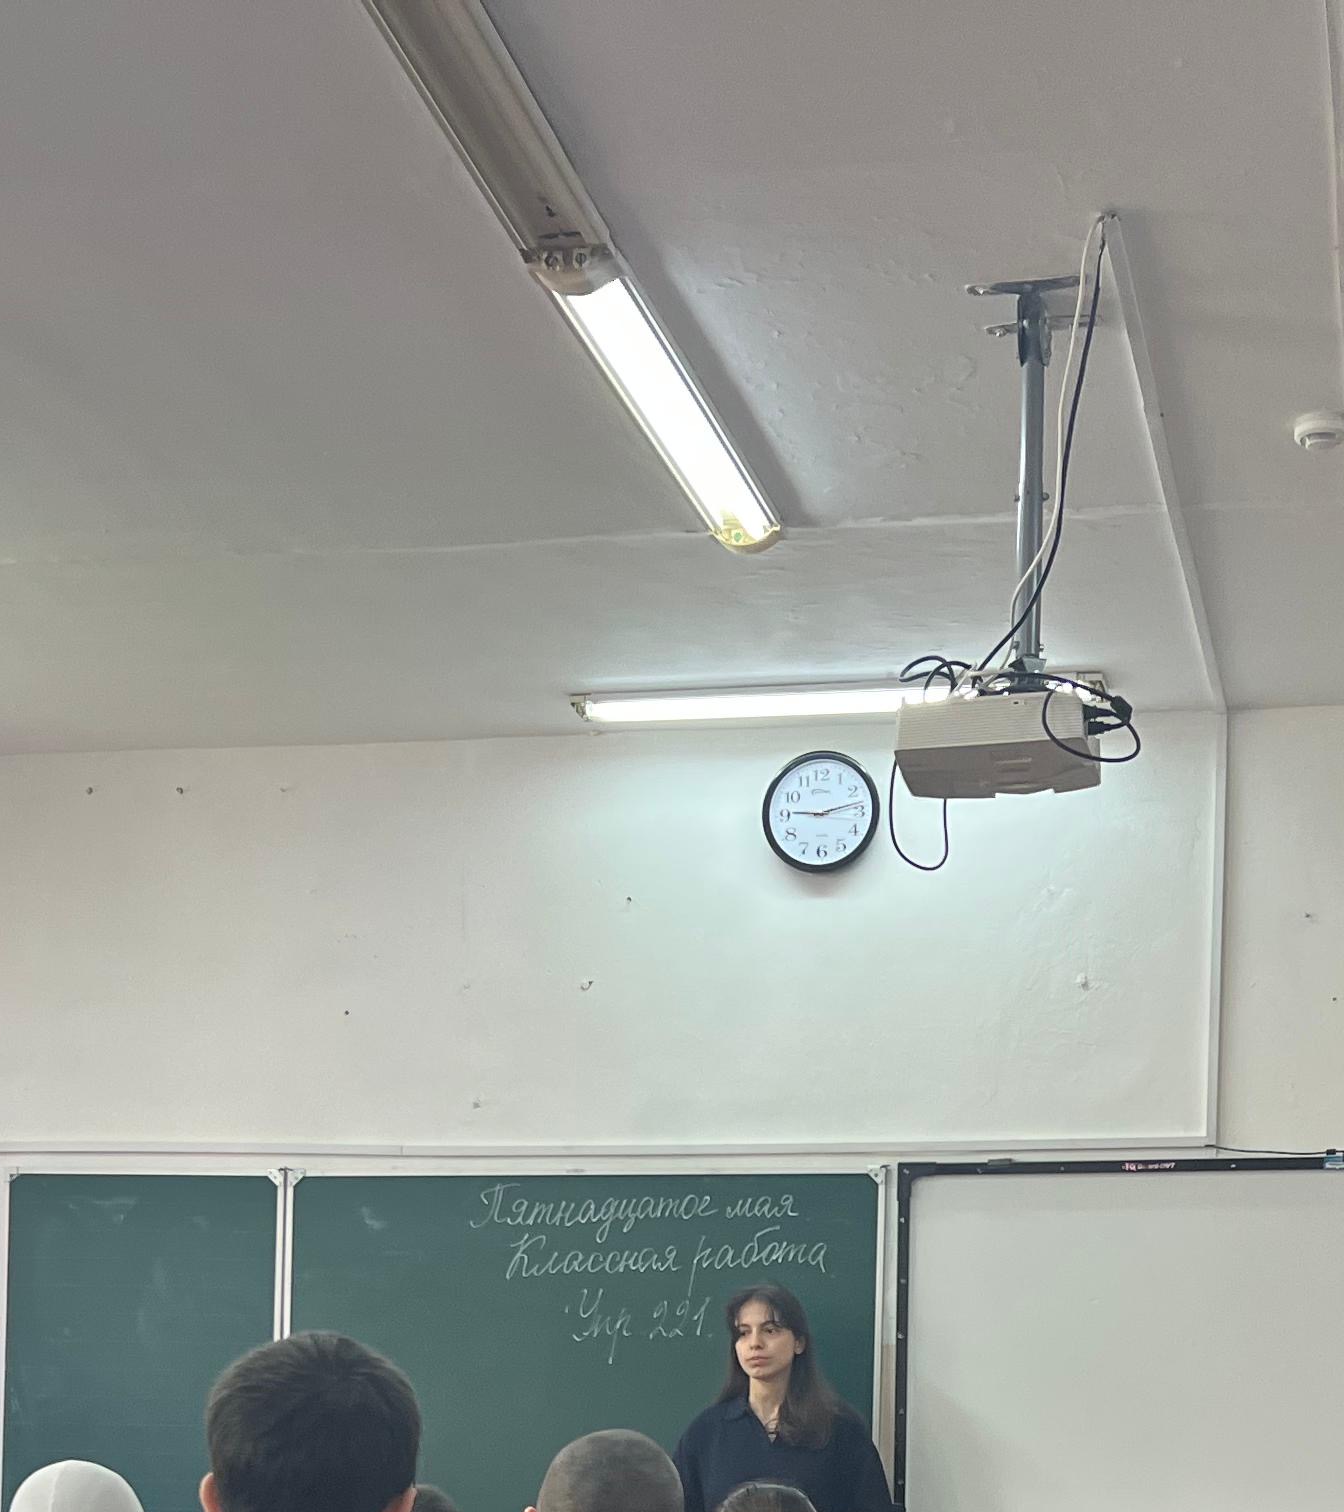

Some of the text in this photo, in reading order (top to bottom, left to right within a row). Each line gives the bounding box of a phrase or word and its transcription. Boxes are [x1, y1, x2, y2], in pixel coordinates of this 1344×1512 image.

[799, 775, 810, 787] 11
[813, 769, 830, 780] 12
[838, 773, 843, 785] 1
[785, 791, 801, 803] 10
[847, 785, 859, 798] 2
[779, 809, 791, 822] 9
[855, 805, 865, 817] 3
[784, 827, 797, 841] 8
[848, 823, 860, 836] 4
[799, 842, 808, 855] 7
[816, 844, 828, 858] 6
[836, 839, 847, 852] 5
[469, 1183, 799, 1244] Пятнадцатое мая
[506, 1225, 827, 1297] Классная работа
